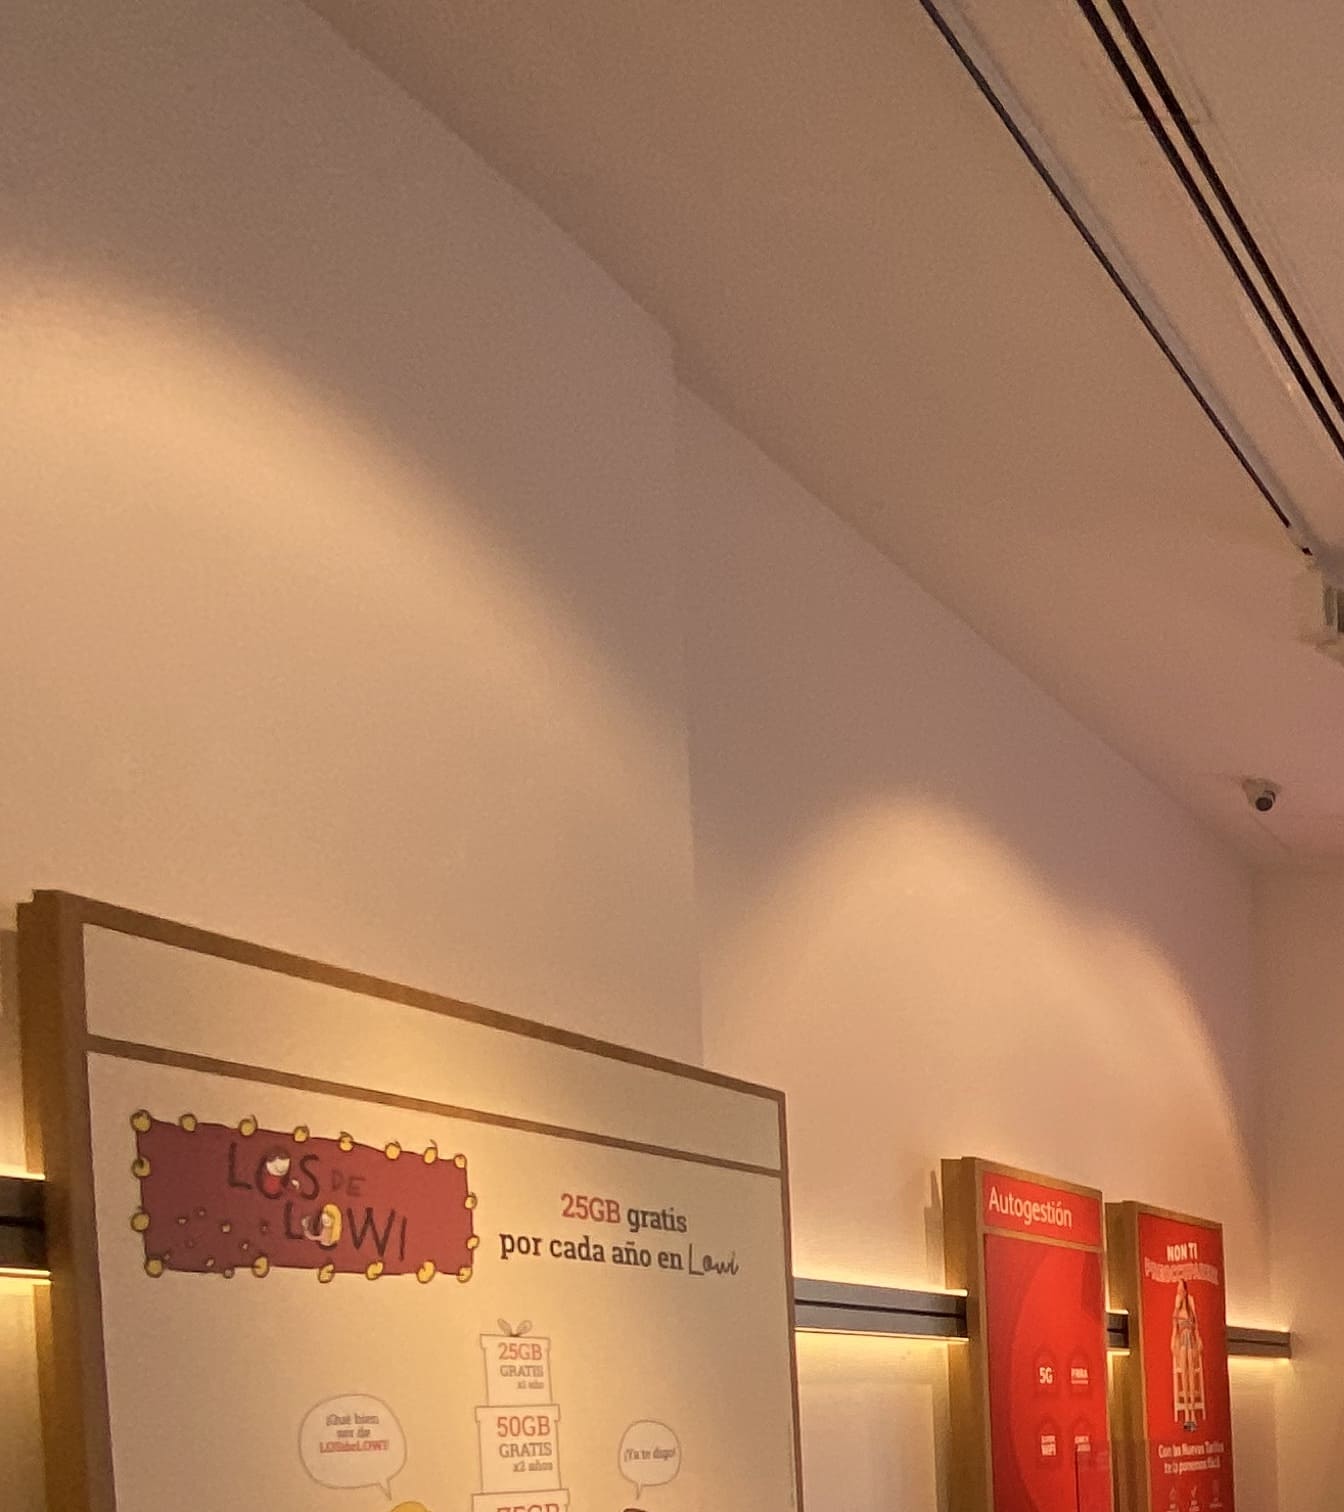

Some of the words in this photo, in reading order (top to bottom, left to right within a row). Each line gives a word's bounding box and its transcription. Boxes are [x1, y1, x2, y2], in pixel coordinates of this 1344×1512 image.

[228, 1141, 320, 1200] LOS
[330, 1168, 367, 1197] DE
[560, 1193, 621, 1224] 25GB
[627, 1206, 688, 1233] gratis
[989, 1185, 1072, 1228] Autogestión
[499, 1233, 543, 1260] por
[550, 1235, 606, 1263] cada
[612, 1241, 652, 1268] año
[658, 1250, 685, 1271] en
[1166, 1243, 1188, 1262] NON
[498, 1342, 543, 1361] 25GB
[500, 1364, 544, 1378] GRATIS
[496, 1415, 551, 1438] 50GB
[498, 1442, 553, 1458] GRATIS
